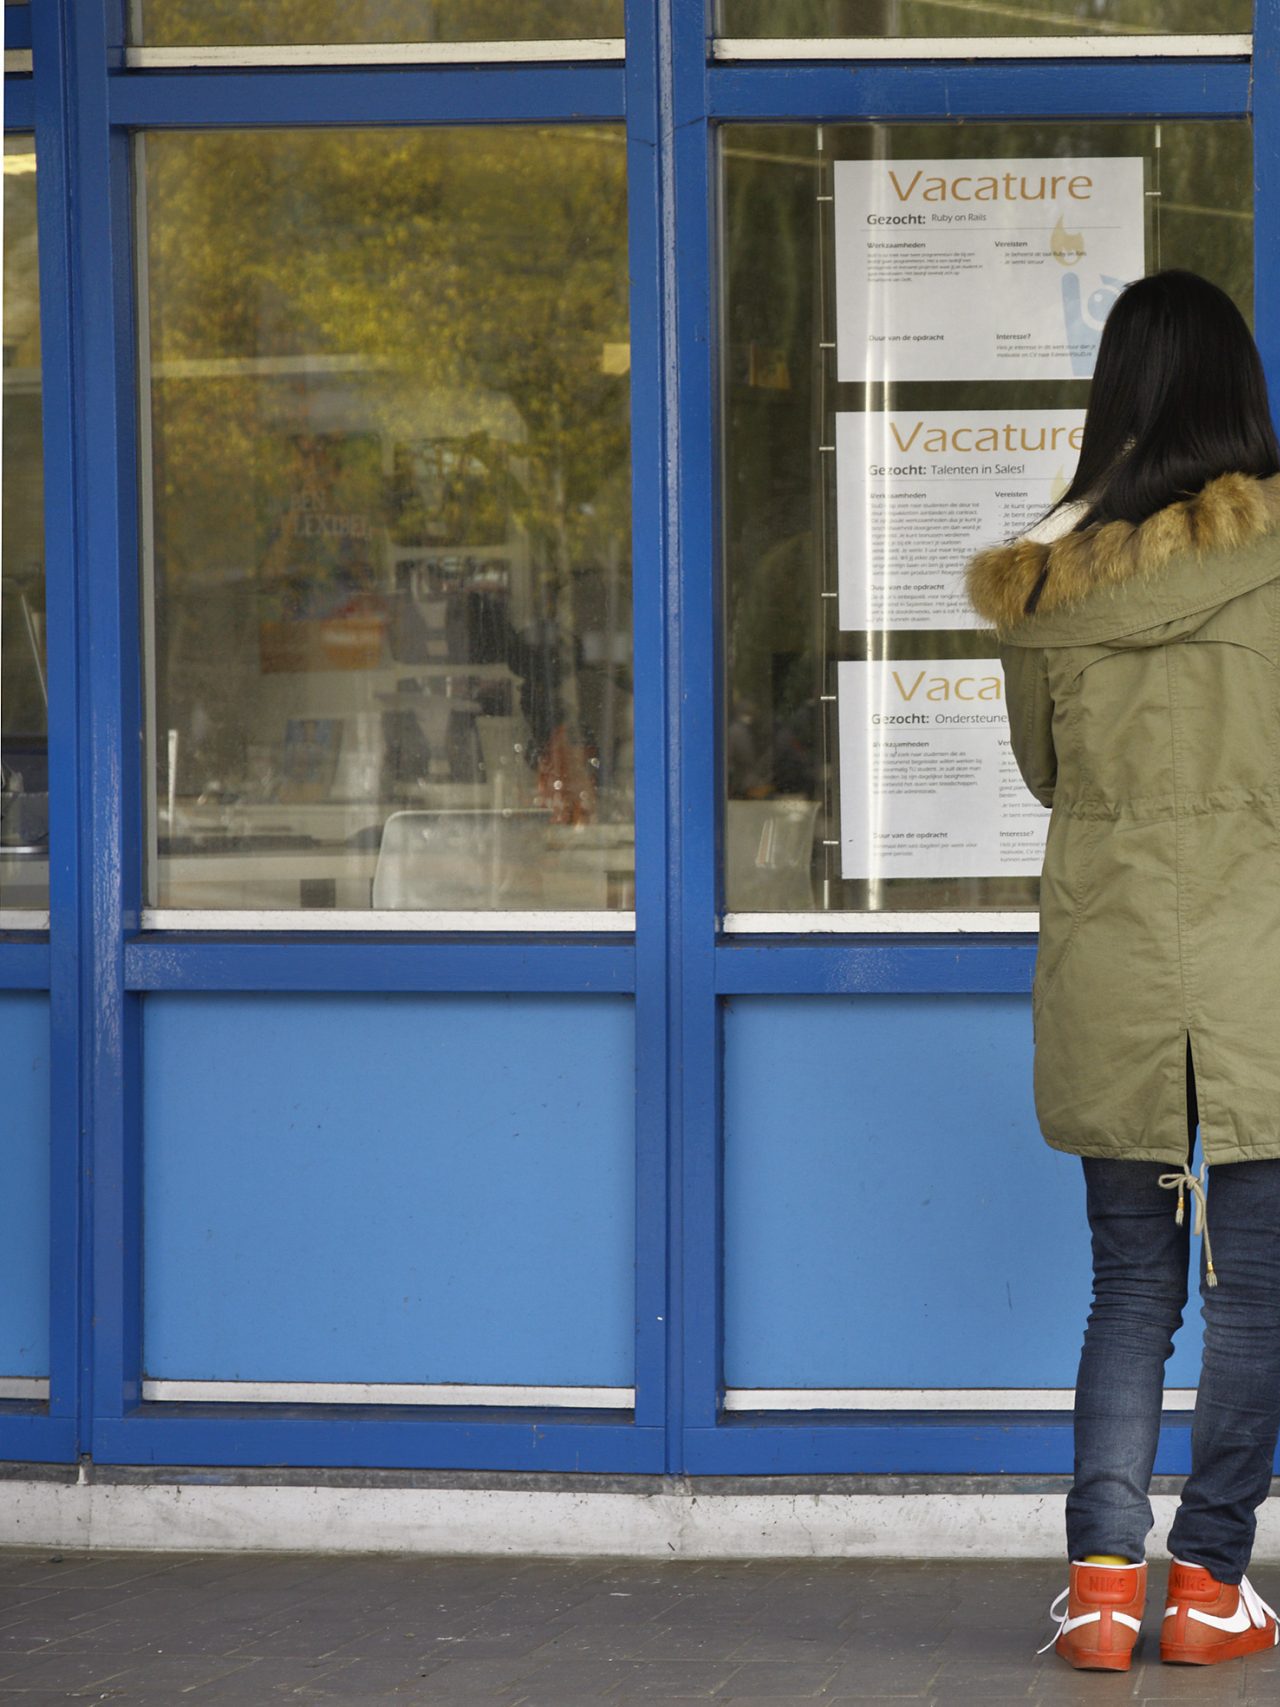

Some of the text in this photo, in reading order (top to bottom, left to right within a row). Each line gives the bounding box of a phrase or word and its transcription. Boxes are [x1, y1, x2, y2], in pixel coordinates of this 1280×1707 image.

[888, 170, 1093, 201] Vacature
[866, 213, 987, 226] Gezocht: Ruby on Rails
[888, 334, 901, 342] van
[902, 334, 912, 342] de
[912, 334, 944, 342] opdracht
[890, 421, 1084, 453] Vacature
[869, 463, 1025, 475] Gezocht: Talenten in Sales!
[1089, 1576, 1126, 1592] NIKE
[1174, 1574, 1206, 1592] NIKE
